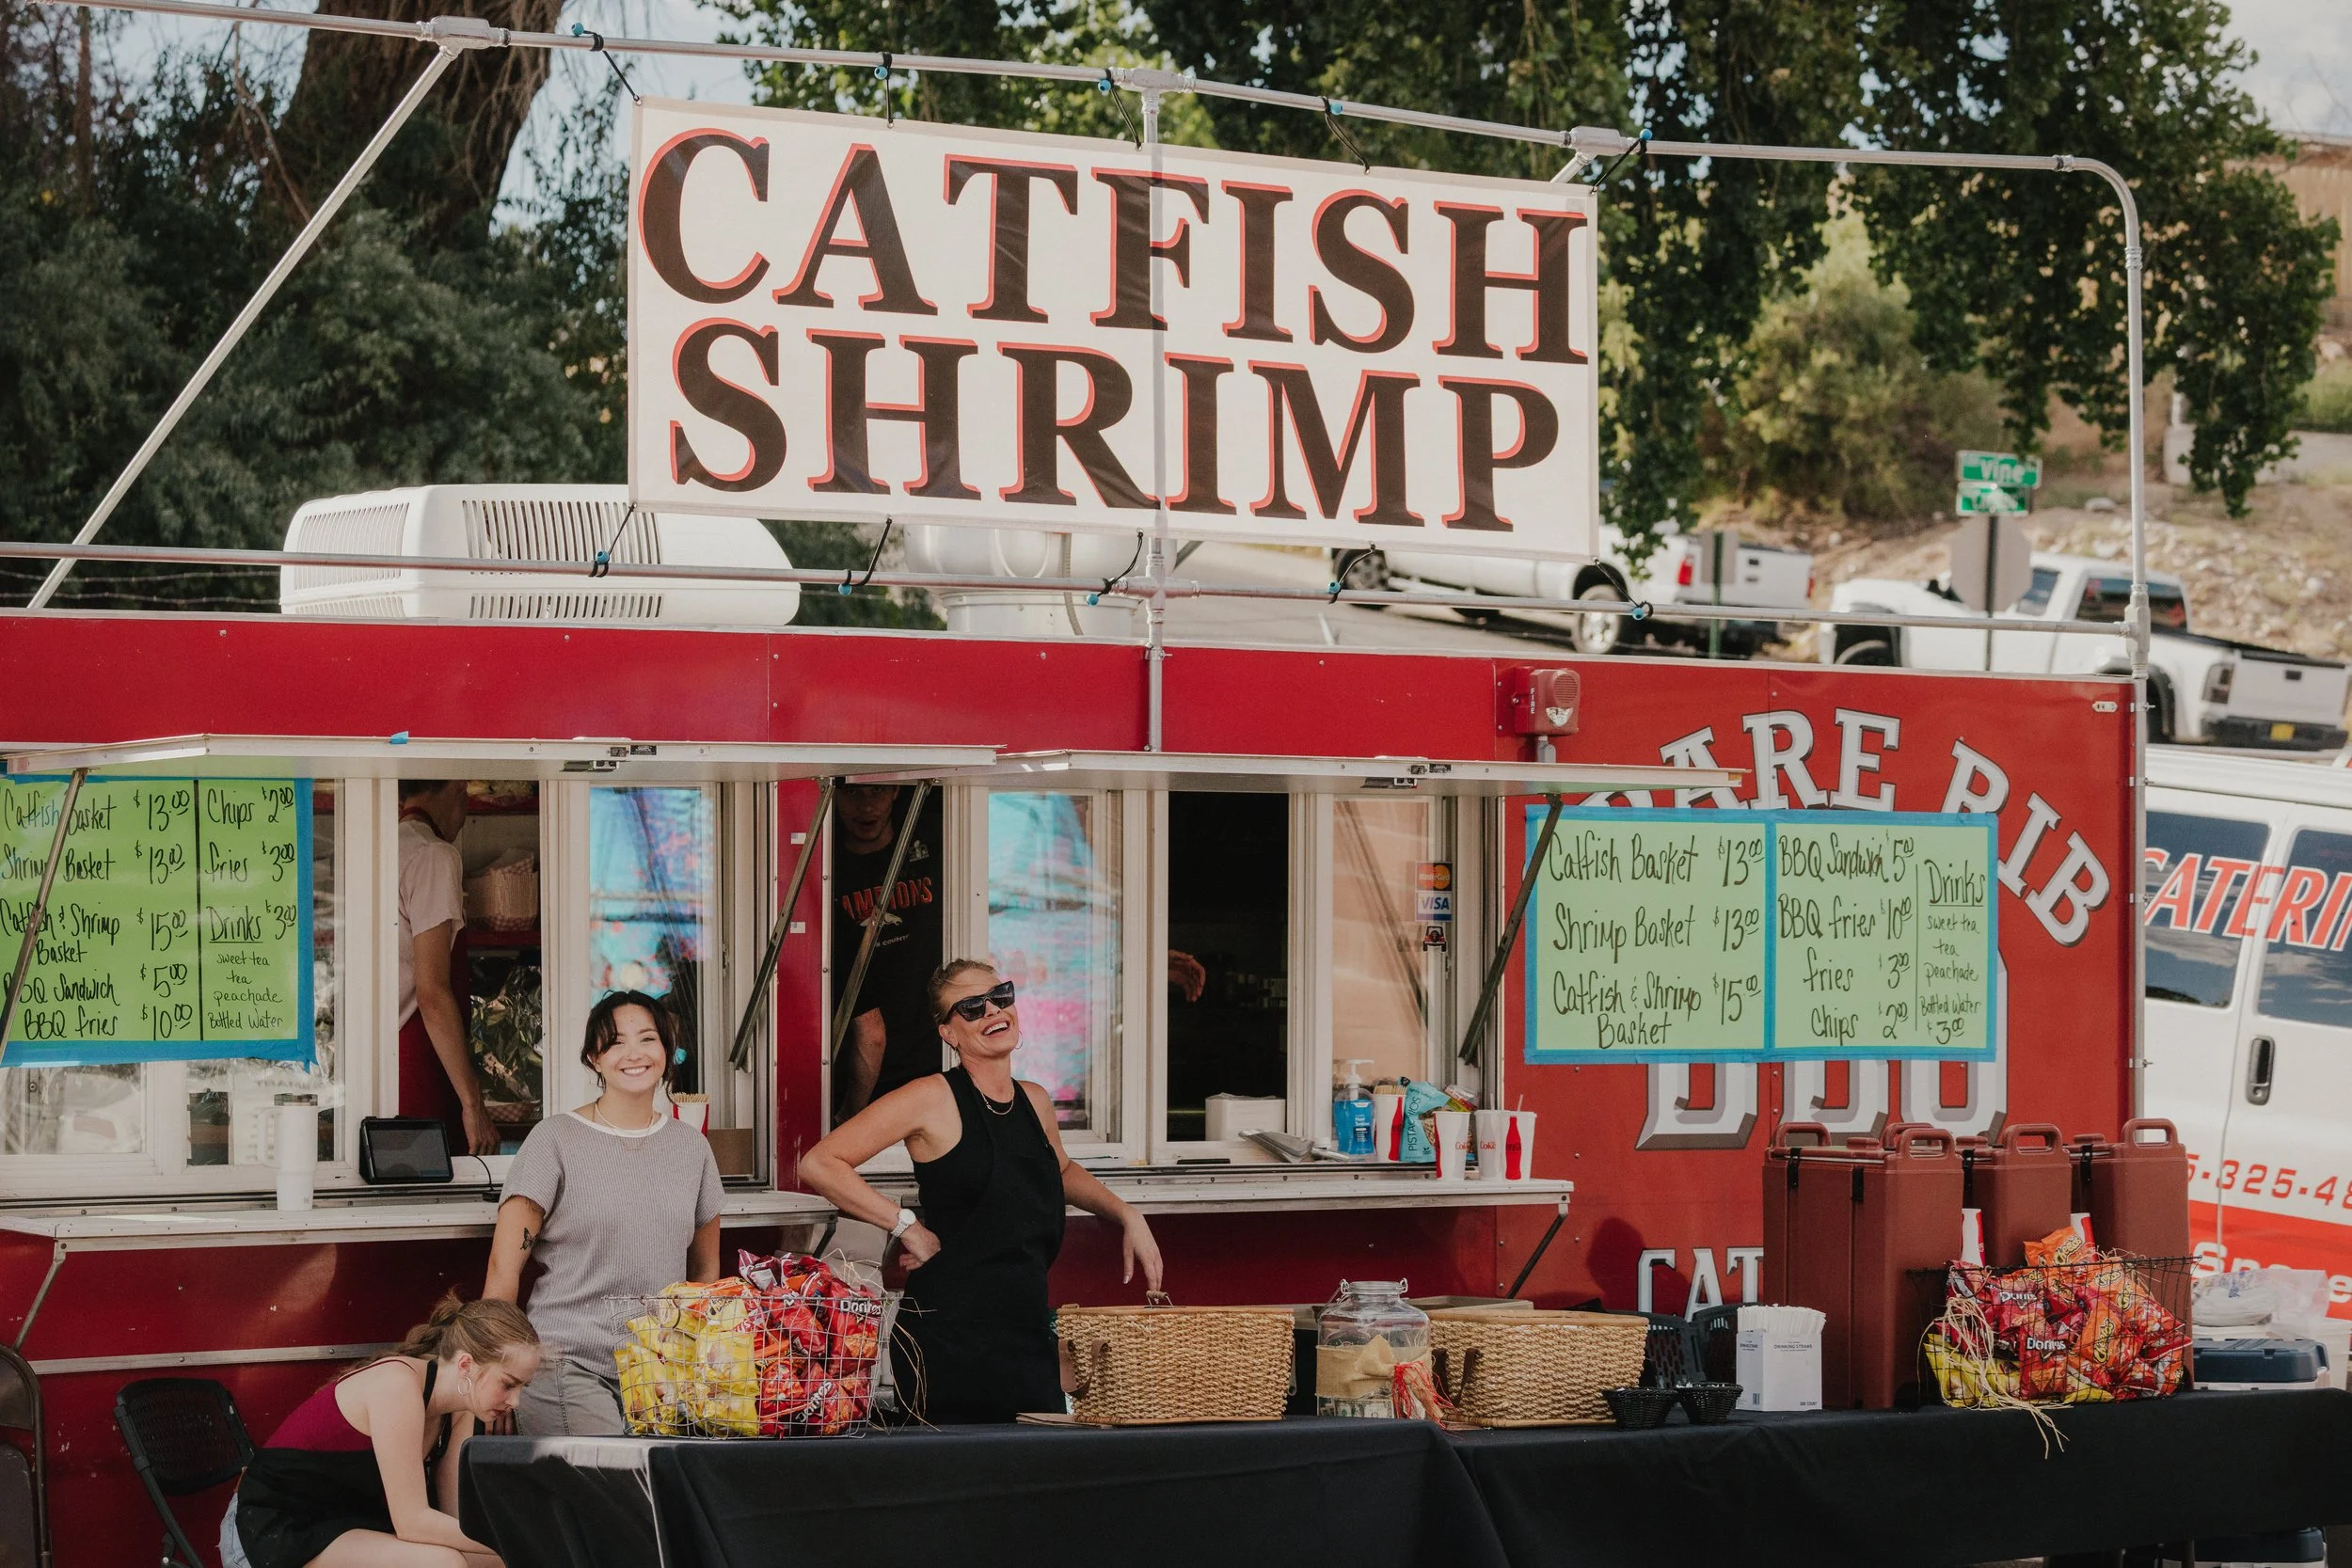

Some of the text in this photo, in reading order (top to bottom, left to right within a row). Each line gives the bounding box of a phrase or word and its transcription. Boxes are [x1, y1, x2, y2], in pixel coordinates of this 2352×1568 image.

[638, 126, 1588, 365] CATFISH
[669, 317, 1561, 532] SHRIMP
[1981, 458, 2026, 483] Vine
[4, 788, 61, 832] Catfish
[208, 788, 255, 830] Chips
[1549, 831, 1622, 882] Catfish
[1631, 833, 1699, 884] Basket
[1778, 835, 1825, 882] BBQ
[1940, 739, 2110, 947] RIB
[2, 843, 48, 881] Shrim
[63, 847, 116, 882] Basket
[1924, 859, 1986, 907] Drinks
[2145, 848, 2352, 952] ATERI
[1422, 896, 1450, 911] VISA
[1778, 894, 1823, 939] BBQ
[71, 901, 120, 946] Shrimp
[206, 905, 262, 943] Drinks
[1553, 903, 1627, 964] Shrimp
[1634, 905, 1696, 948] Basket
[1927, 912, 1980, 934] sweet tea
[36, 939, 87, 966] Basket
[216, 952, 269, 967] sweet tea
[1933, 939, 1960, 957] tea
[54, 969, 120, 1006] Sandwich
[214, 990, 282, 1005] peachade
[226, 974, 252, 986] tea
[1553, 970, 1626, 1015] Catfish
[1644, 971, 1702, 1022] Shrimp
[24, 1007, 67, 1040] BBQ
[208, 1012, 283, 1030] Bottled Water
[1597, 1011, 1672, 1049] Basket
[1810, 1004, 1859, 1046] Chips
[1480, 1141, 1497, 1150] Coke
[840, 1300, 882, 1316] Doritos
